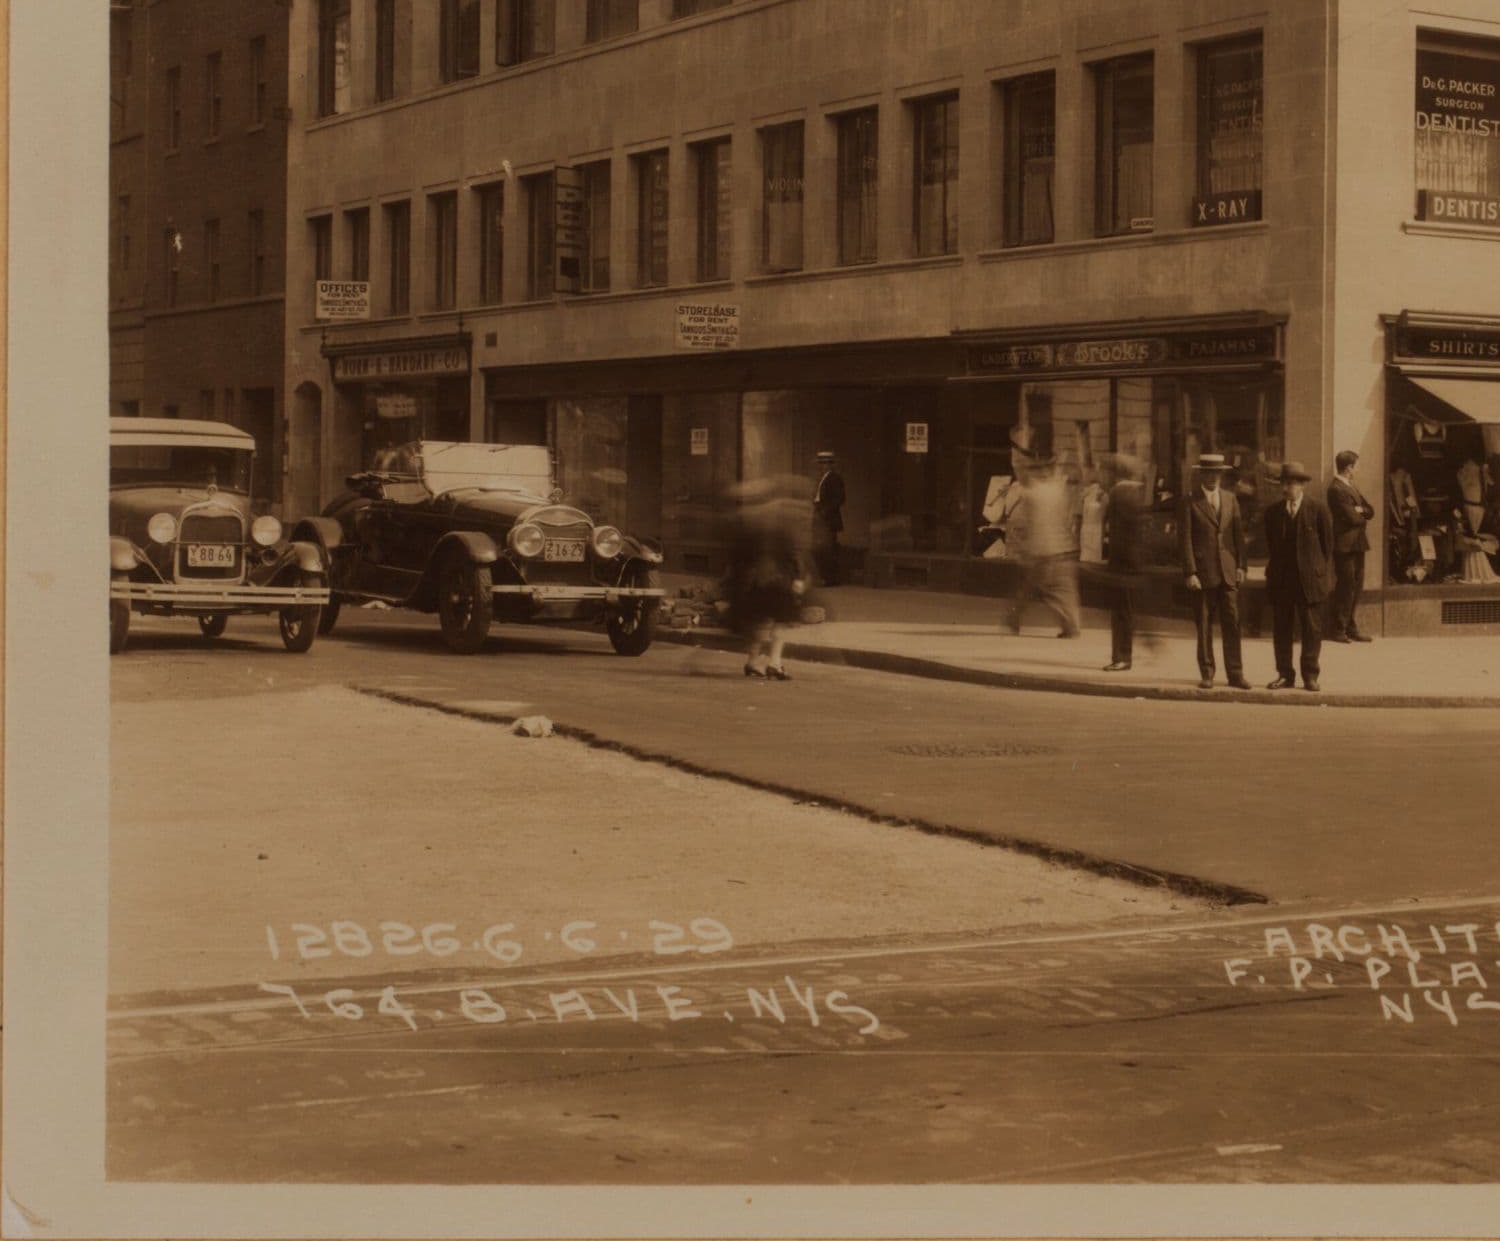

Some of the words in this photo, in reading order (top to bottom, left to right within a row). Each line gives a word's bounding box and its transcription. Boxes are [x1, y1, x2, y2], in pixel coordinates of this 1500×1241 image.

[1449, 80, 1496, 97] PACKER
[1436, 97, 1484, 110] SURGEON
[1199, 198, 1248, 222] X-RAY
[320, 283, 367, 293] OFFICES
[1190, 339, 1257, 356] PAJAMAS
[1429, 338, 1500, 357] SHIRTS
